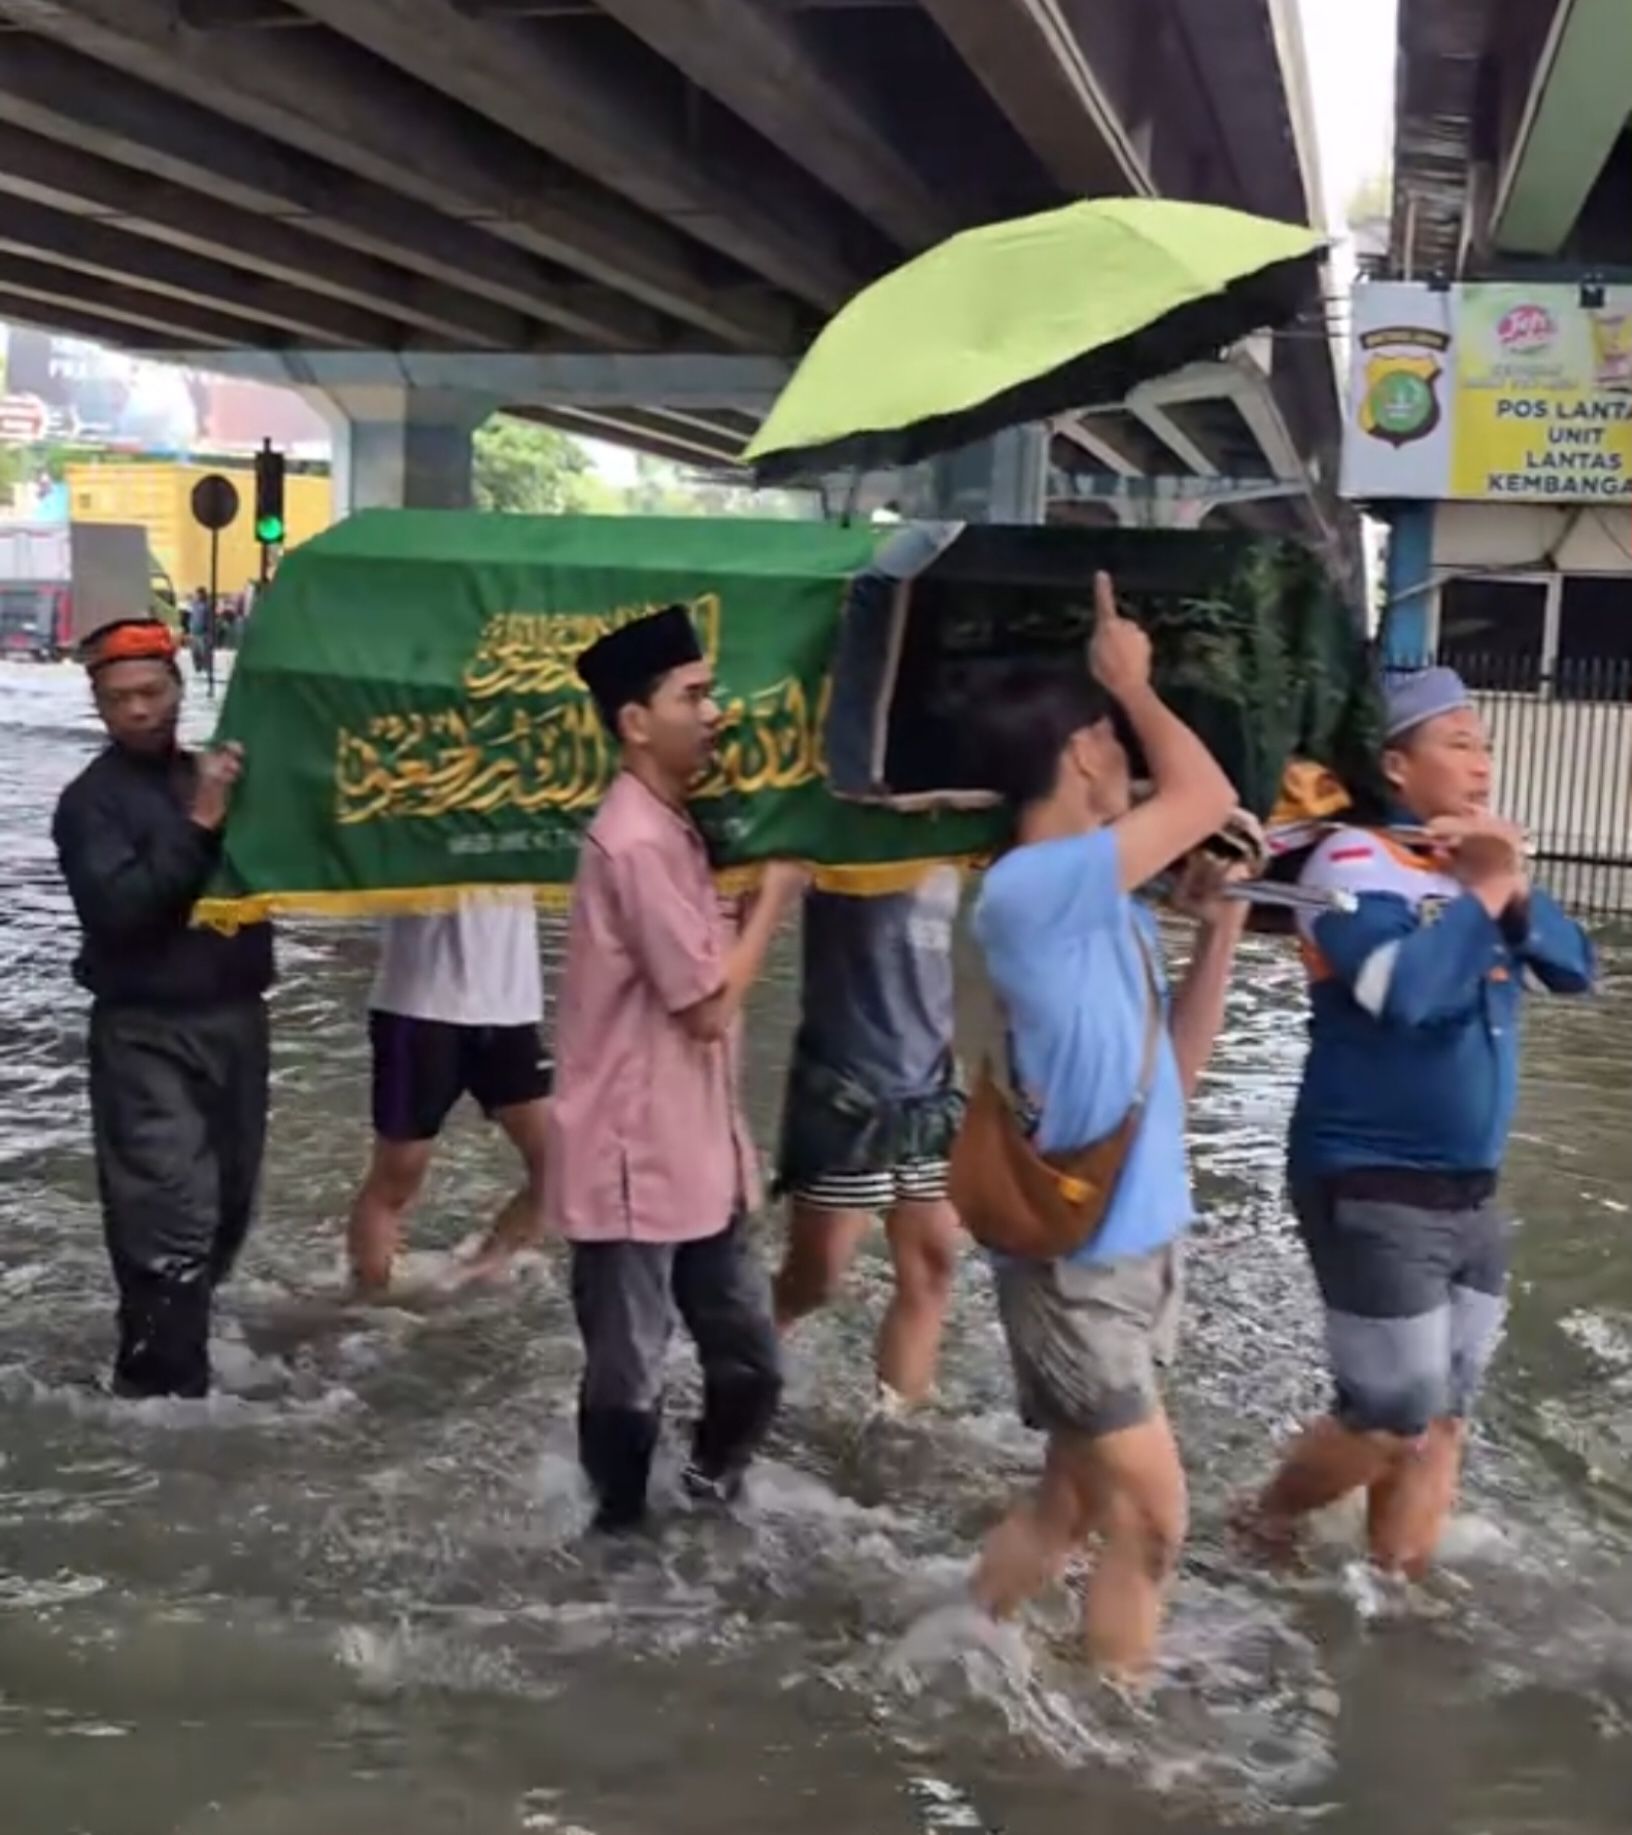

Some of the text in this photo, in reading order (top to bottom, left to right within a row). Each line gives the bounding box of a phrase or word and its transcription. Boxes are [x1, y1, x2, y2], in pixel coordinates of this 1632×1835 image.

[1496, 399, 1547, 418] POS
[1548, 426, 1605, 445] UNIT
[1526, 451, 1622, 470] LANTAS
[1487, 473, 1632, 495] KEMBANGA
